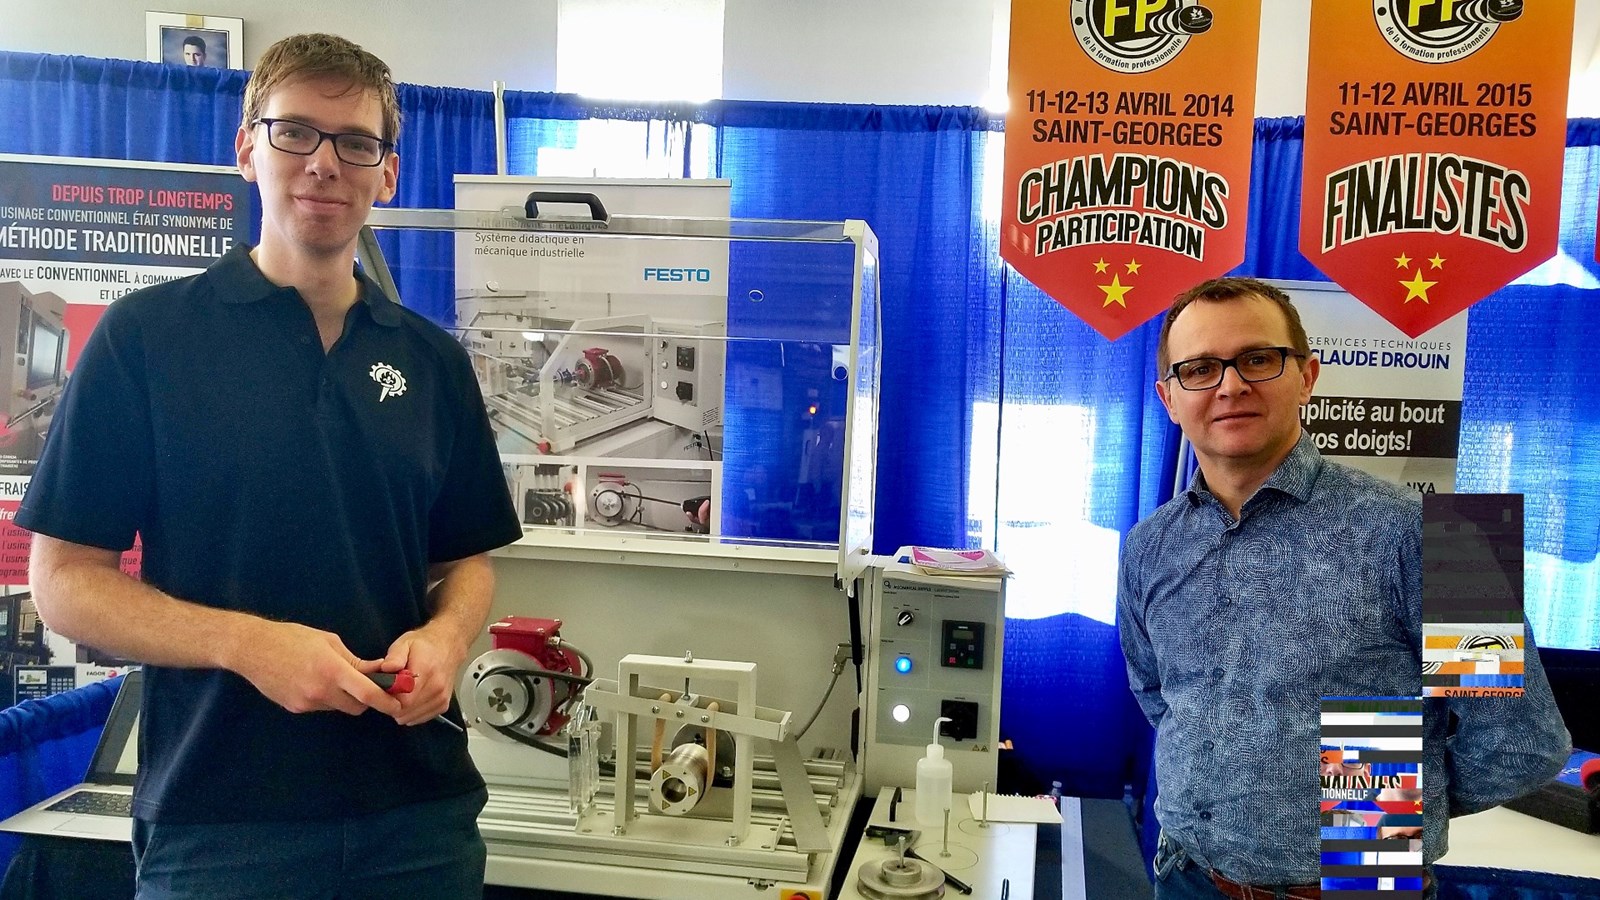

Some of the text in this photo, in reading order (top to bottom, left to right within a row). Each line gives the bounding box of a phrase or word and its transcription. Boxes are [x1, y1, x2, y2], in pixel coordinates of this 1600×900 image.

[1082, 35, 1182, 70] de la formation professionnelle
[1385, 26, 1491, 60] de la formation professionnelle
[1026, 89, 1234, 117] 11-12-13 AVRIL 2014
[1338, 82, 1532, 107] 11-12 AVRIL 2015
[1032, 119, 1223, 146] SAINT-GEORGES
[1330, 111, 1537, 137] SAINT-GEORGES
[53, 185, 233, 211] DEPUIS TROP LONGTEMPS
[1019, 155, 1228, 229] CHAMPIONS
[1324, 155, 1529, 251] FINALISTES
[47, 208, 130, 225] CONVENTIONNEL
[133, 211, 159, 226] ÉTAIT
[162, 214, 217, 230] SYNONYME
[220, 217, 233, 230] DE
[82, 229, 232, 258] TRADITIONNELLE
[475, 232, 584, 245] Système didactique en
[1036, 212, 1204, 259] PARTICIPATION
[475, 246, 585, 258] mécanique industrielle
[0, 268, 21, 279] AVEC
[24, 269, 34, 279] LE
[37, 266, 130, 284] CONVENTIONNEL
[134, 271, 140, 284] À
[644, 268, 710, 282] FESTO
[100, 289, 109, 300] ET
[1308, 336, 1451, 351] SERVICES TECHNIQUES
[1381, 351, 1450, 369] DROUIN
[1371, 405, 1394, 422] au
[1400, 401, 1445, 424] bout
[1344, 428, 1412, 456] doigts!
